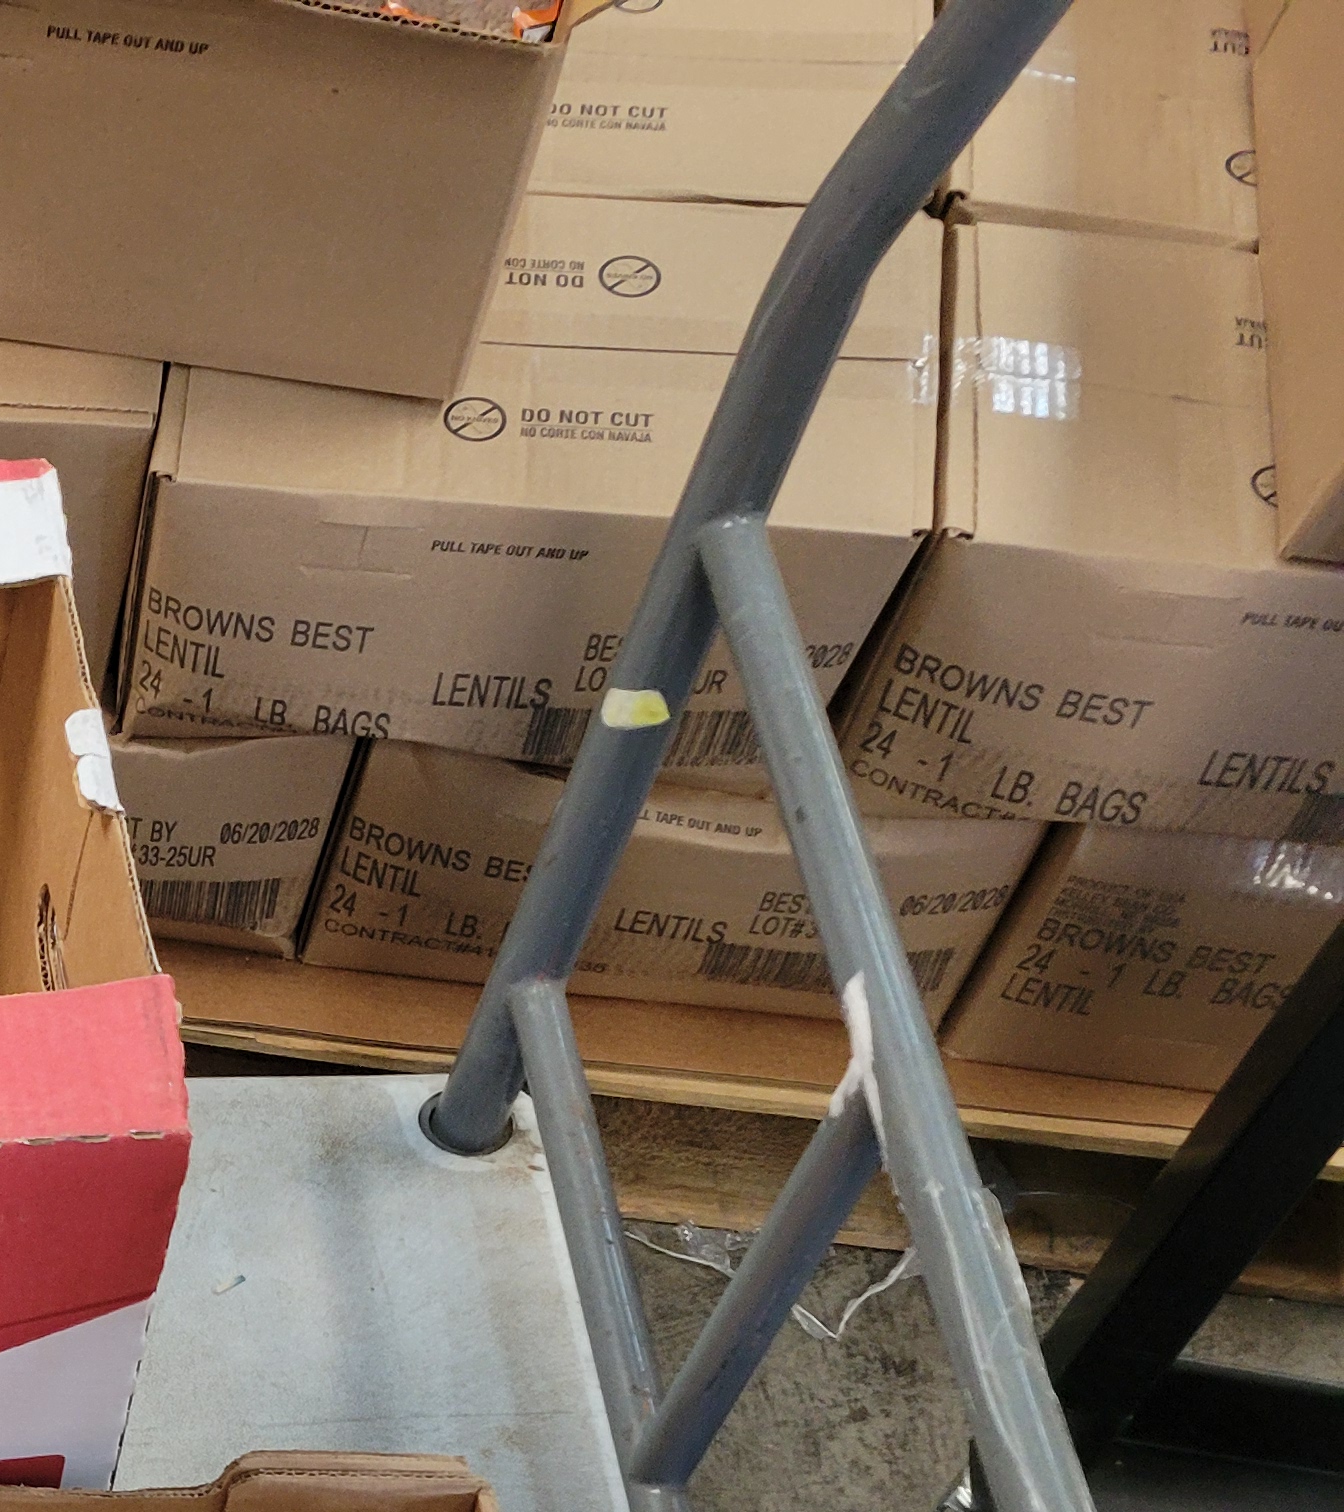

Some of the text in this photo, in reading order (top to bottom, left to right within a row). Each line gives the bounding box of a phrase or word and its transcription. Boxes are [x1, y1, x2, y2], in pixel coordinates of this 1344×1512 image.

[46, 24, 209, 55] PULL TAPE OUT AND UP
[580, 104, 669, 119] NOT CUT
[505, 272, 584, 288] DO NOT
[520, 427, 536, 437] NO
[581, 429, 604, 440] CON
[521, 408, 655, 428] DO NOT CUT
[430, 539, 589, 560] PULL TAPE OUT AND UP
[148, 587, 375, 653] BROWNS BEST
[143, 619, 225, 678] LENTIL
[139, 660, 390, 739] 24 BAGS
[431, 671, 552, 709] LENTILS
[895, 644, 1044, 711] BROWNS
[1056, 690, 1153, 729] BEST
[878, 680, 974, 744] LENTIL
[859, 720, 898, 760] 24
[1055, 781, 1148, 825] BAGS
[1198, 750, 1335, 796] LENTILS
[150, 820, 178, 842] BY
[220, 817, 321, 846] 06/20/2028
[656, 811, 684, 826] TAPE
[688, 818, 711, 831] OUT
[715, 823, 741, 836] AND
[745, 827, 763, 837] UP
[348, 816, 472, 872] BROWNS
[340, 846, 421, 898] LENTIL
[328, 883, 357, 917] 24
[614, 908, 728, 944] LENTILS
[1016, 944, 1056, 973] 24
[1037, 918, 1276, 974] BROWNS BEST
[1001, 973, 1095, 1016] LENTIL
